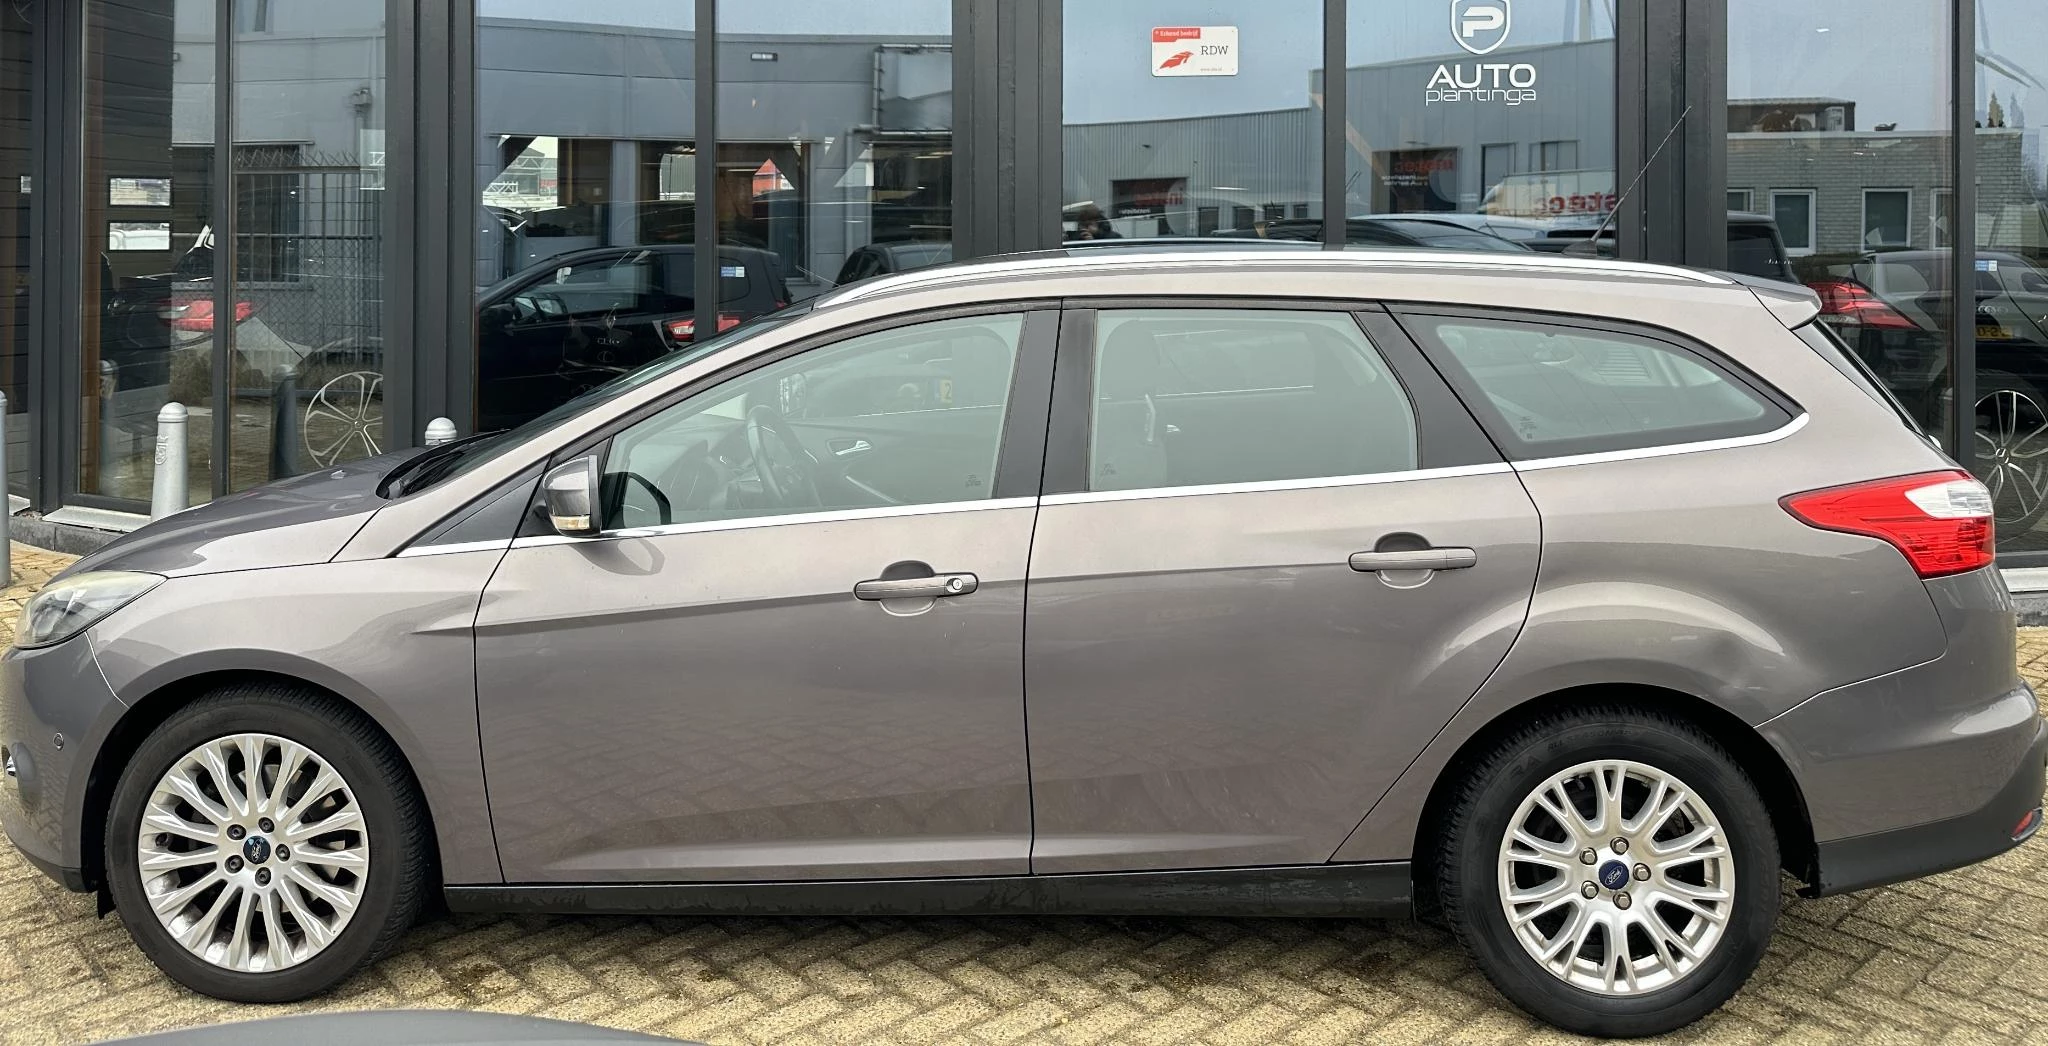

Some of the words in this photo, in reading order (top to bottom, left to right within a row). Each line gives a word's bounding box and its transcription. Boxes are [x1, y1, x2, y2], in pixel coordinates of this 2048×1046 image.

[1462, 6, 1505, 37] P
[1201, 45, 1229, 56] RDW
[1426, 63, 1536, 89] AUTO
[1425, 87, 1537, 106] plantinga
